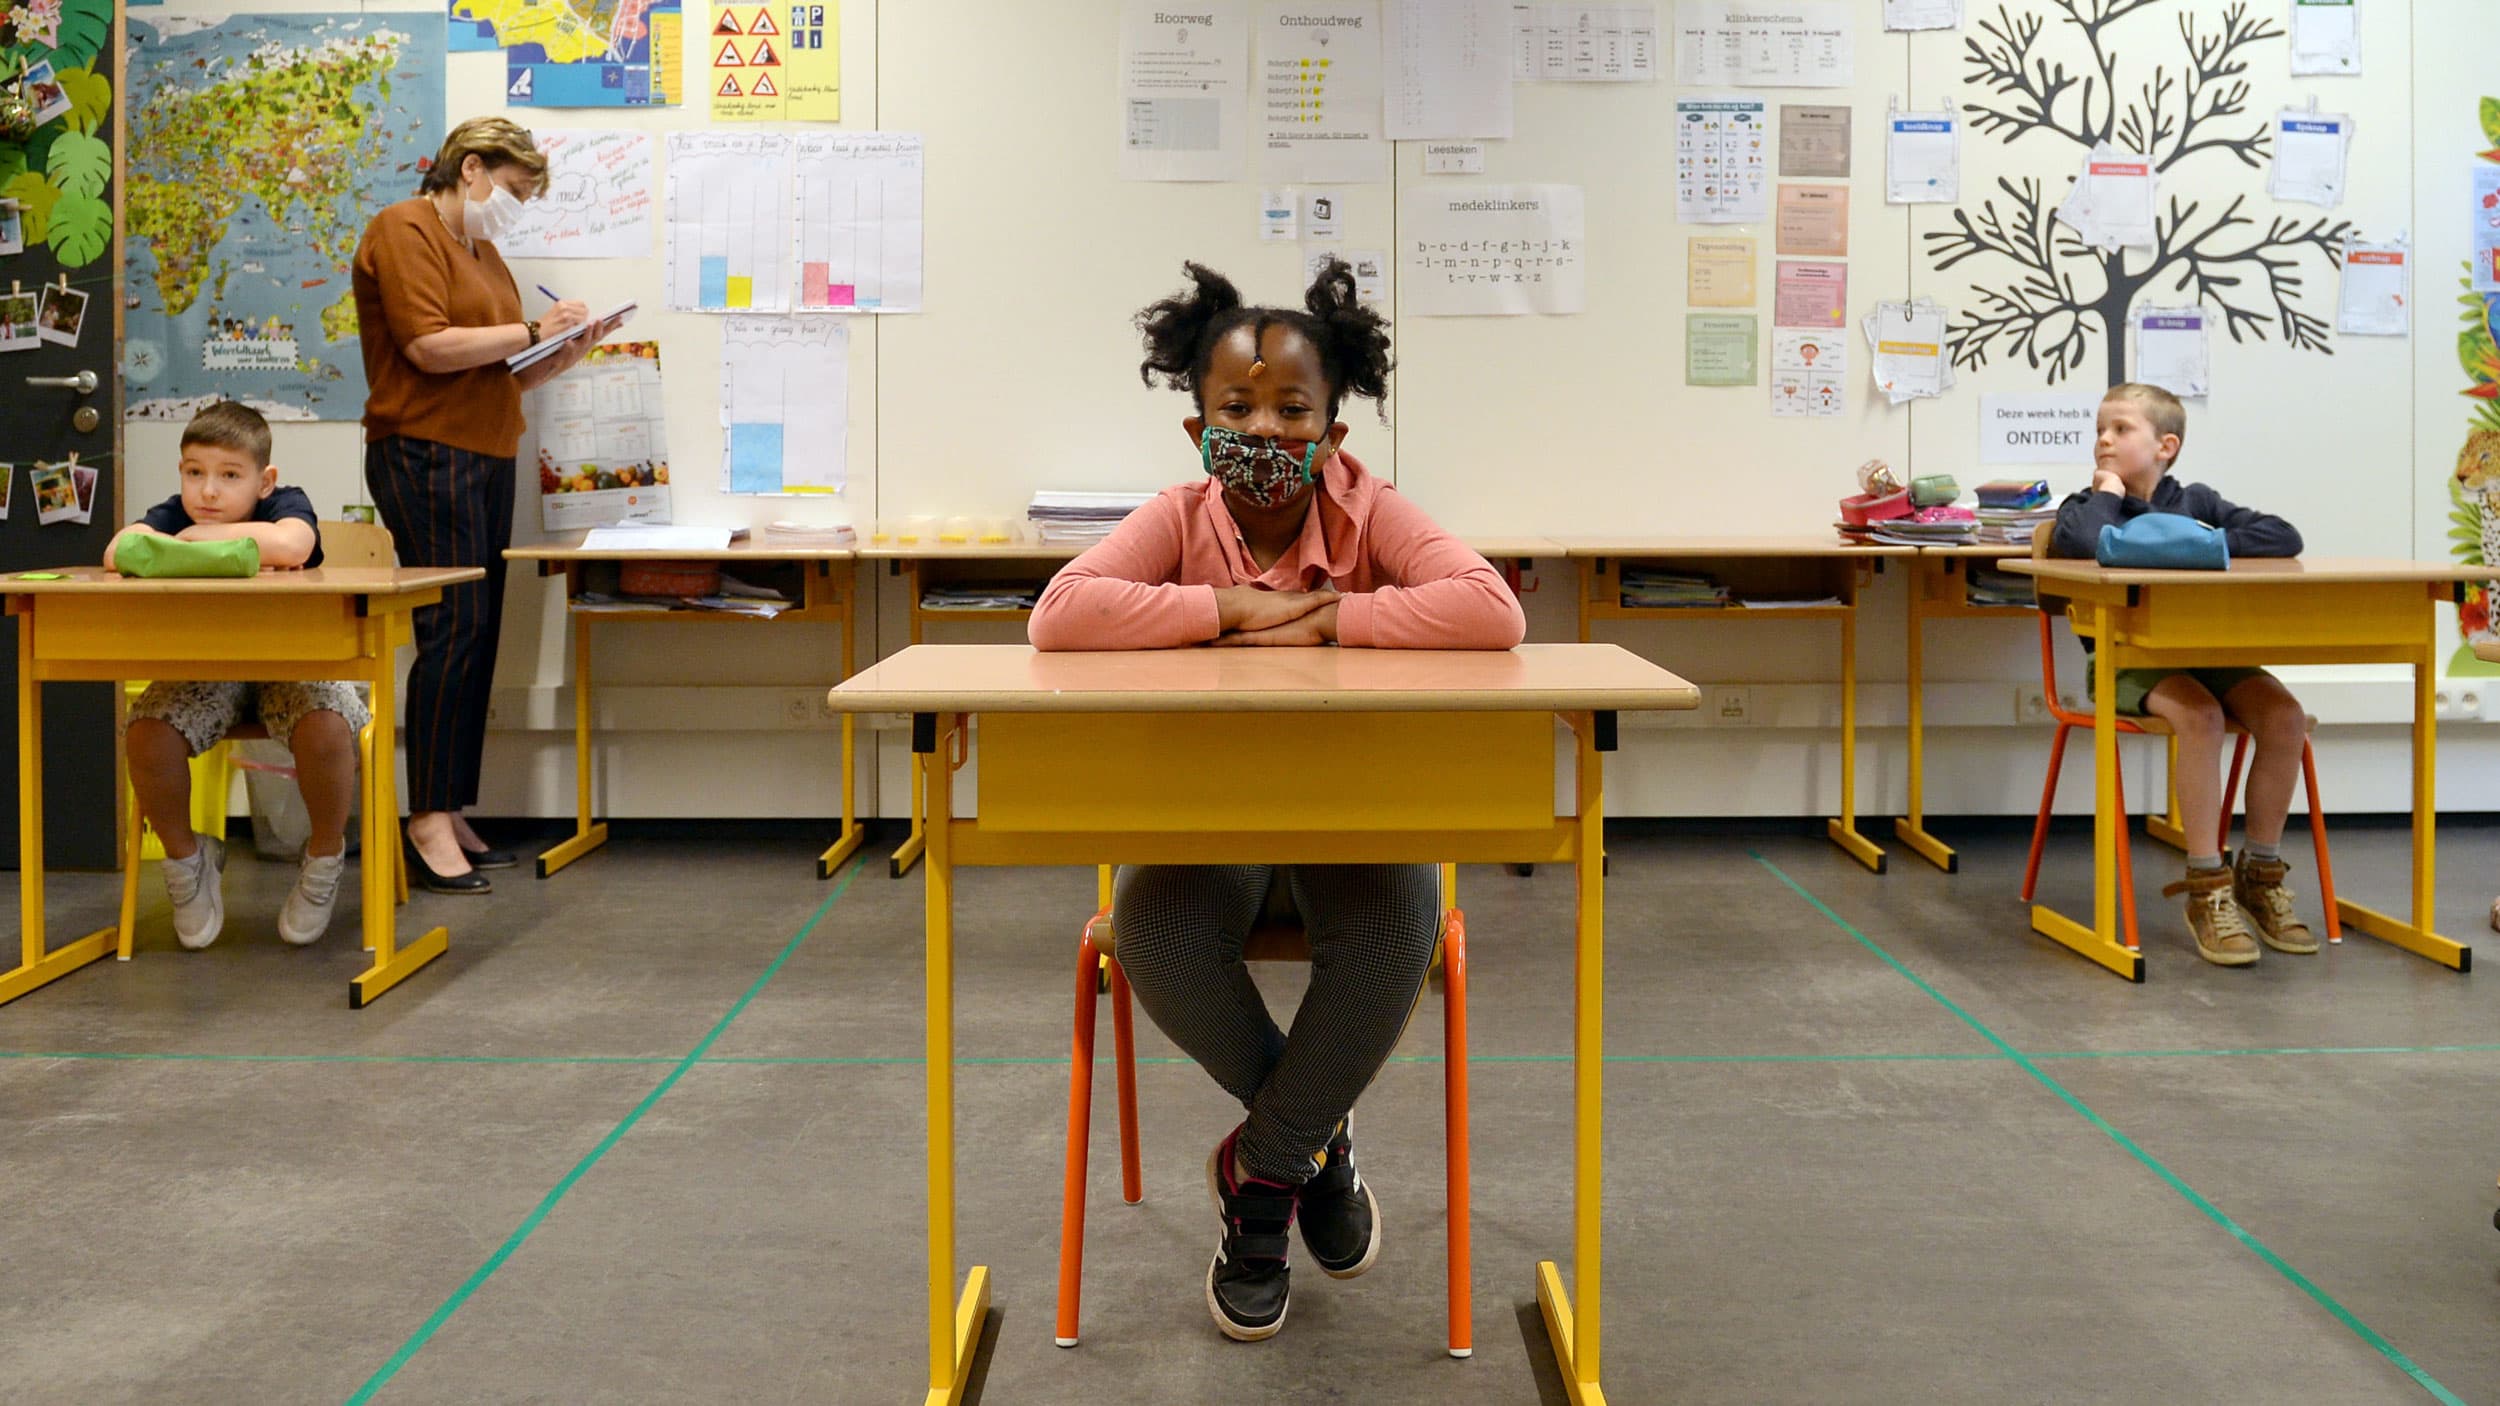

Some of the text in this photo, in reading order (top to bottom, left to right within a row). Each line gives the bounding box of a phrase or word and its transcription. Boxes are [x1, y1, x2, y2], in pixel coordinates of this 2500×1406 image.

[1154, 13, 1214, 26] Hoorweg
[1279, 16, 1363, 29] Onthoudweg
[1725, 13, 1804, 23] klinkerschema
[1428, 144, 1478, 154] Leesteken
[1449, 199, 1540, 211] medeklinkers
[1997, 408, 2024, 419] Deze
[2027, 408, 2055, 419] week
[2059, 408, 2080, 419] heb
[2006, 430, 2081, 445] ONTDEKT
